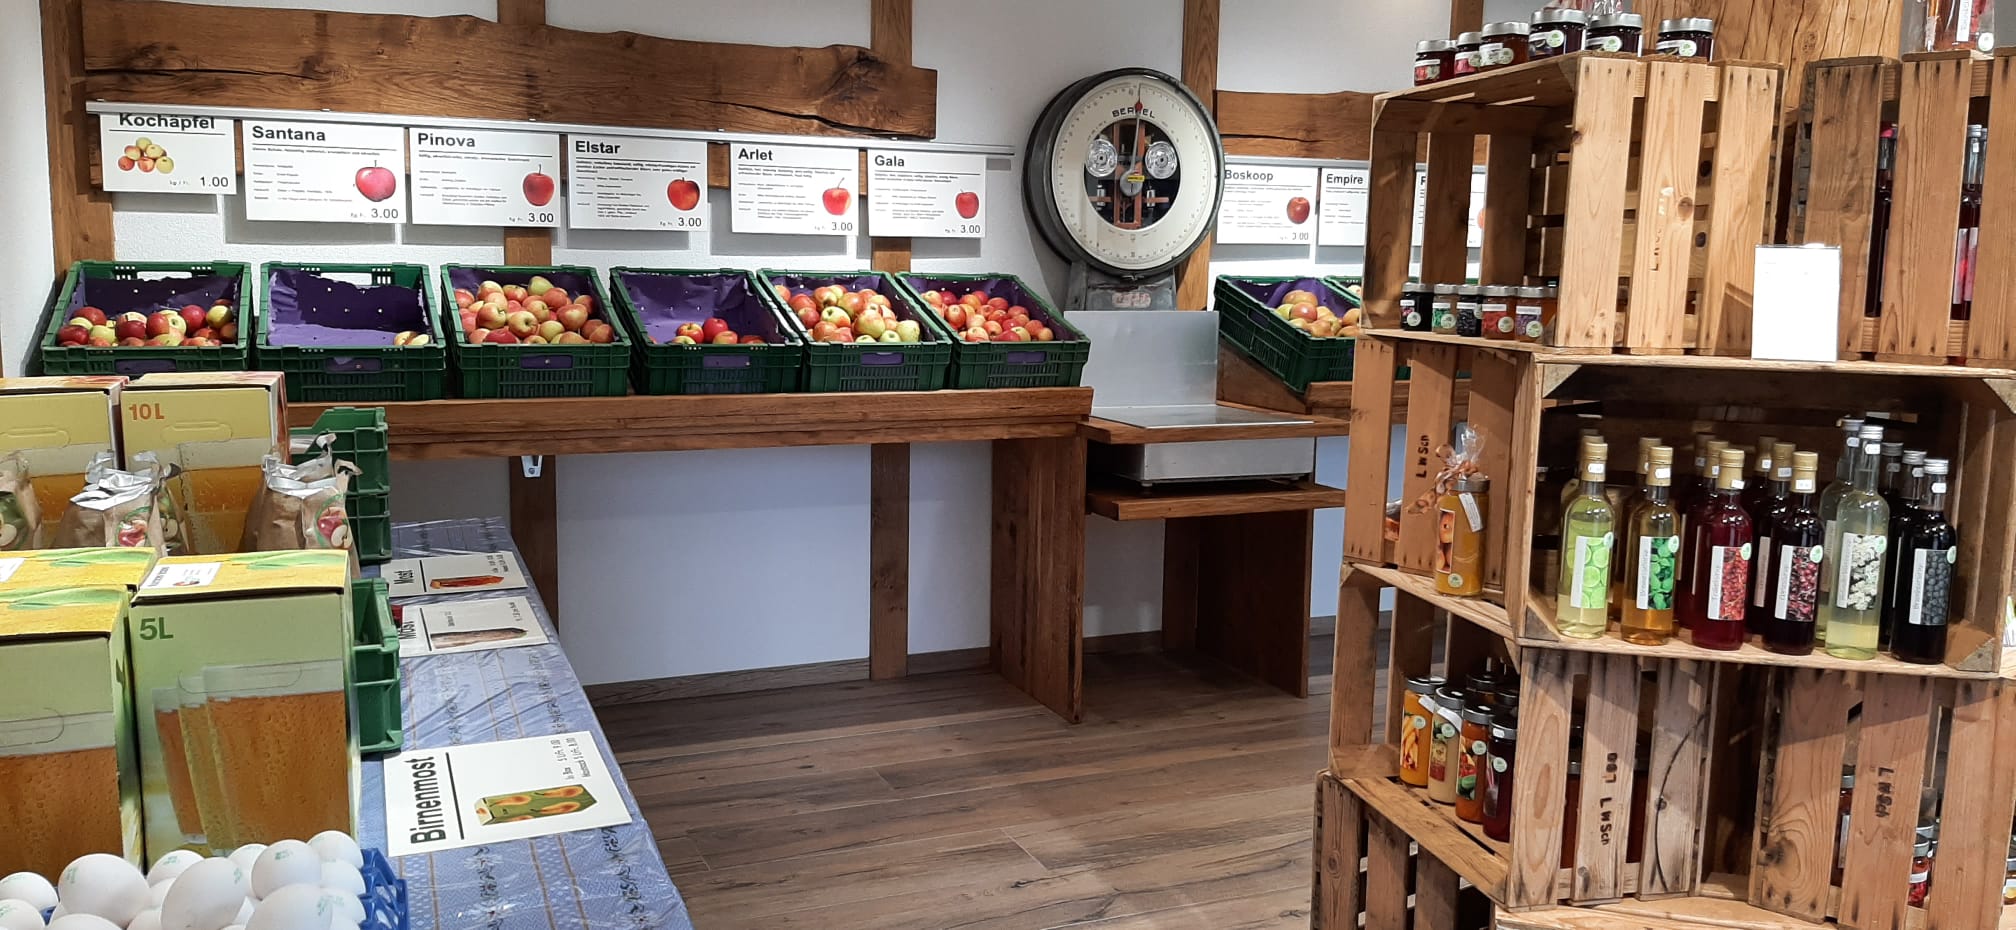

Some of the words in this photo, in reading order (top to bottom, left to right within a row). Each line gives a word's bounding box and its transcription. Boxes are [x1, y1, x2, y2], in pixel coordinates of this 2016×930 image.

[1111, 106, 1156, 119] BEREL
[119, 112, 216, 131] Kochäpfel
[252, 125, 327, 142] Santana
[418, 132, 476, 148] Pinova
[575, 140, 621, 154] Elstar
[738, 148, 773, 162] Arlet
[874, 155, 905, 167] Gala
[199, 176, 229, 187] 1.00
[1224, 169, 1274, 183] Boskoop
[1326, 173, 1364, 186] Empire
[371, 208, 399, 219] 3.00
[528, 212, 554, 223] 3.00
[677, 216, 702, 227] 3.00
[831, 221, 853, 232] 3.00
[960, 224, 981, 234] 3.00
[394, 569, 414, 585] Most
[139, 617, 174, 640] 5L
[397, 620, 417, 640] Most
[404, 755, 447, 844] Birnenmost
